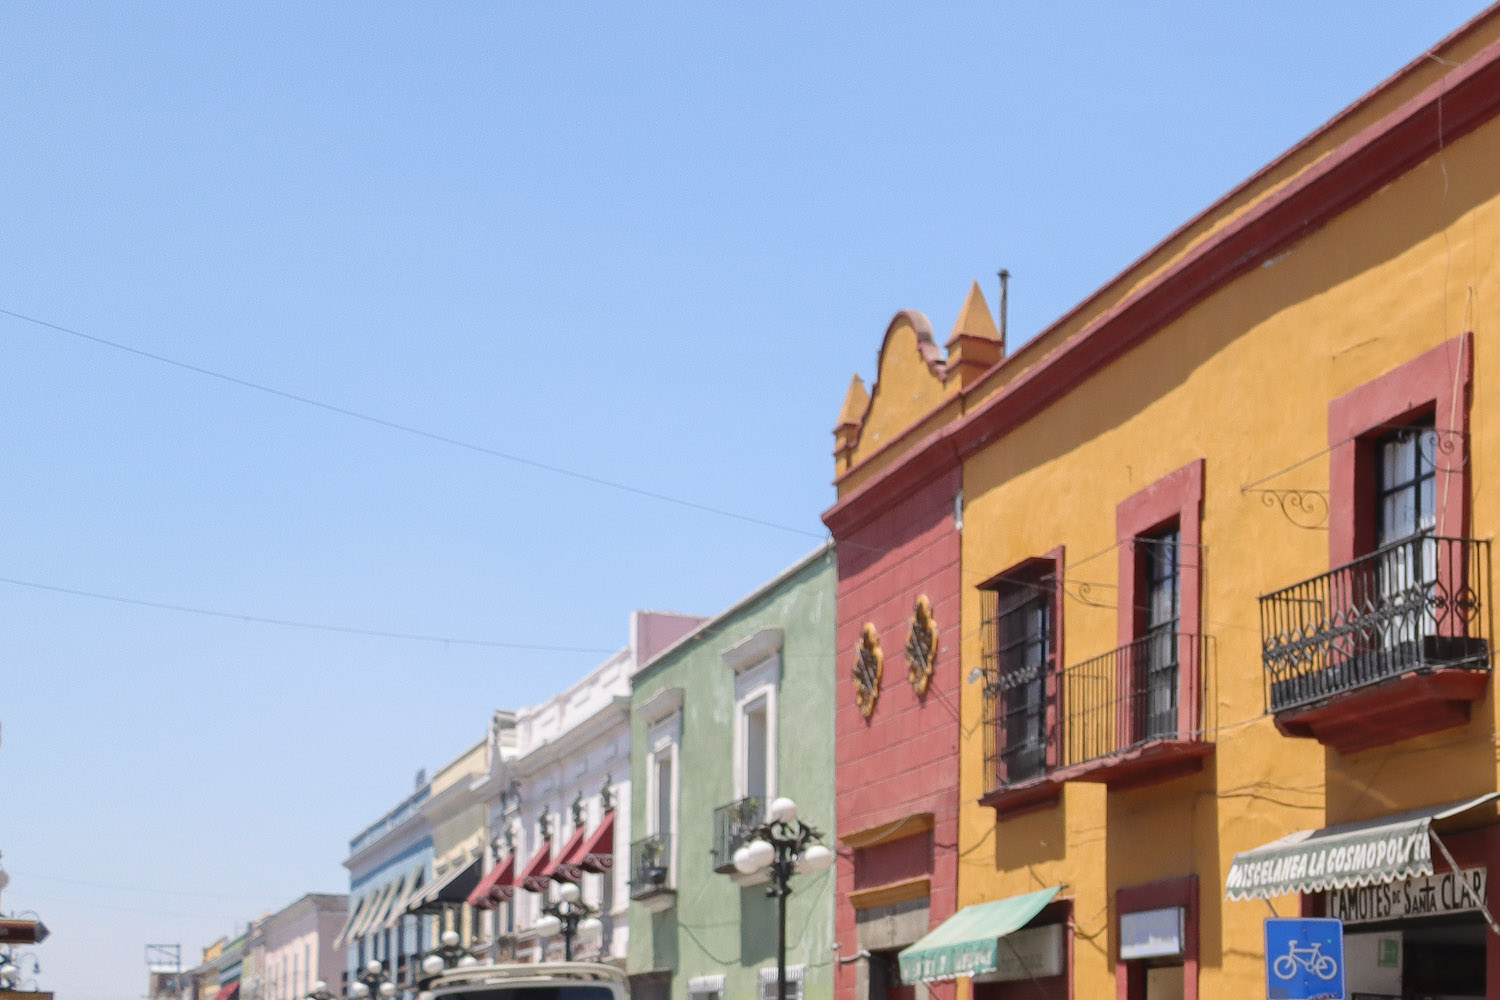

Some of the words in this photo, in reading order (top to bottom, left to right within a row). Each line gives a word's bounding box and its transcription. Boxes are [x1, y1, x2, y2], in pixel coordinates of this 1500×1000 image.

[1226, 850, 1309, 888] MISCELANEA
[1308, 852, 1325, 878] LA
[1326, 832, 1431, 874] COSMOPOLITA
[1331, 883, 1391, 920] CAMOTES
